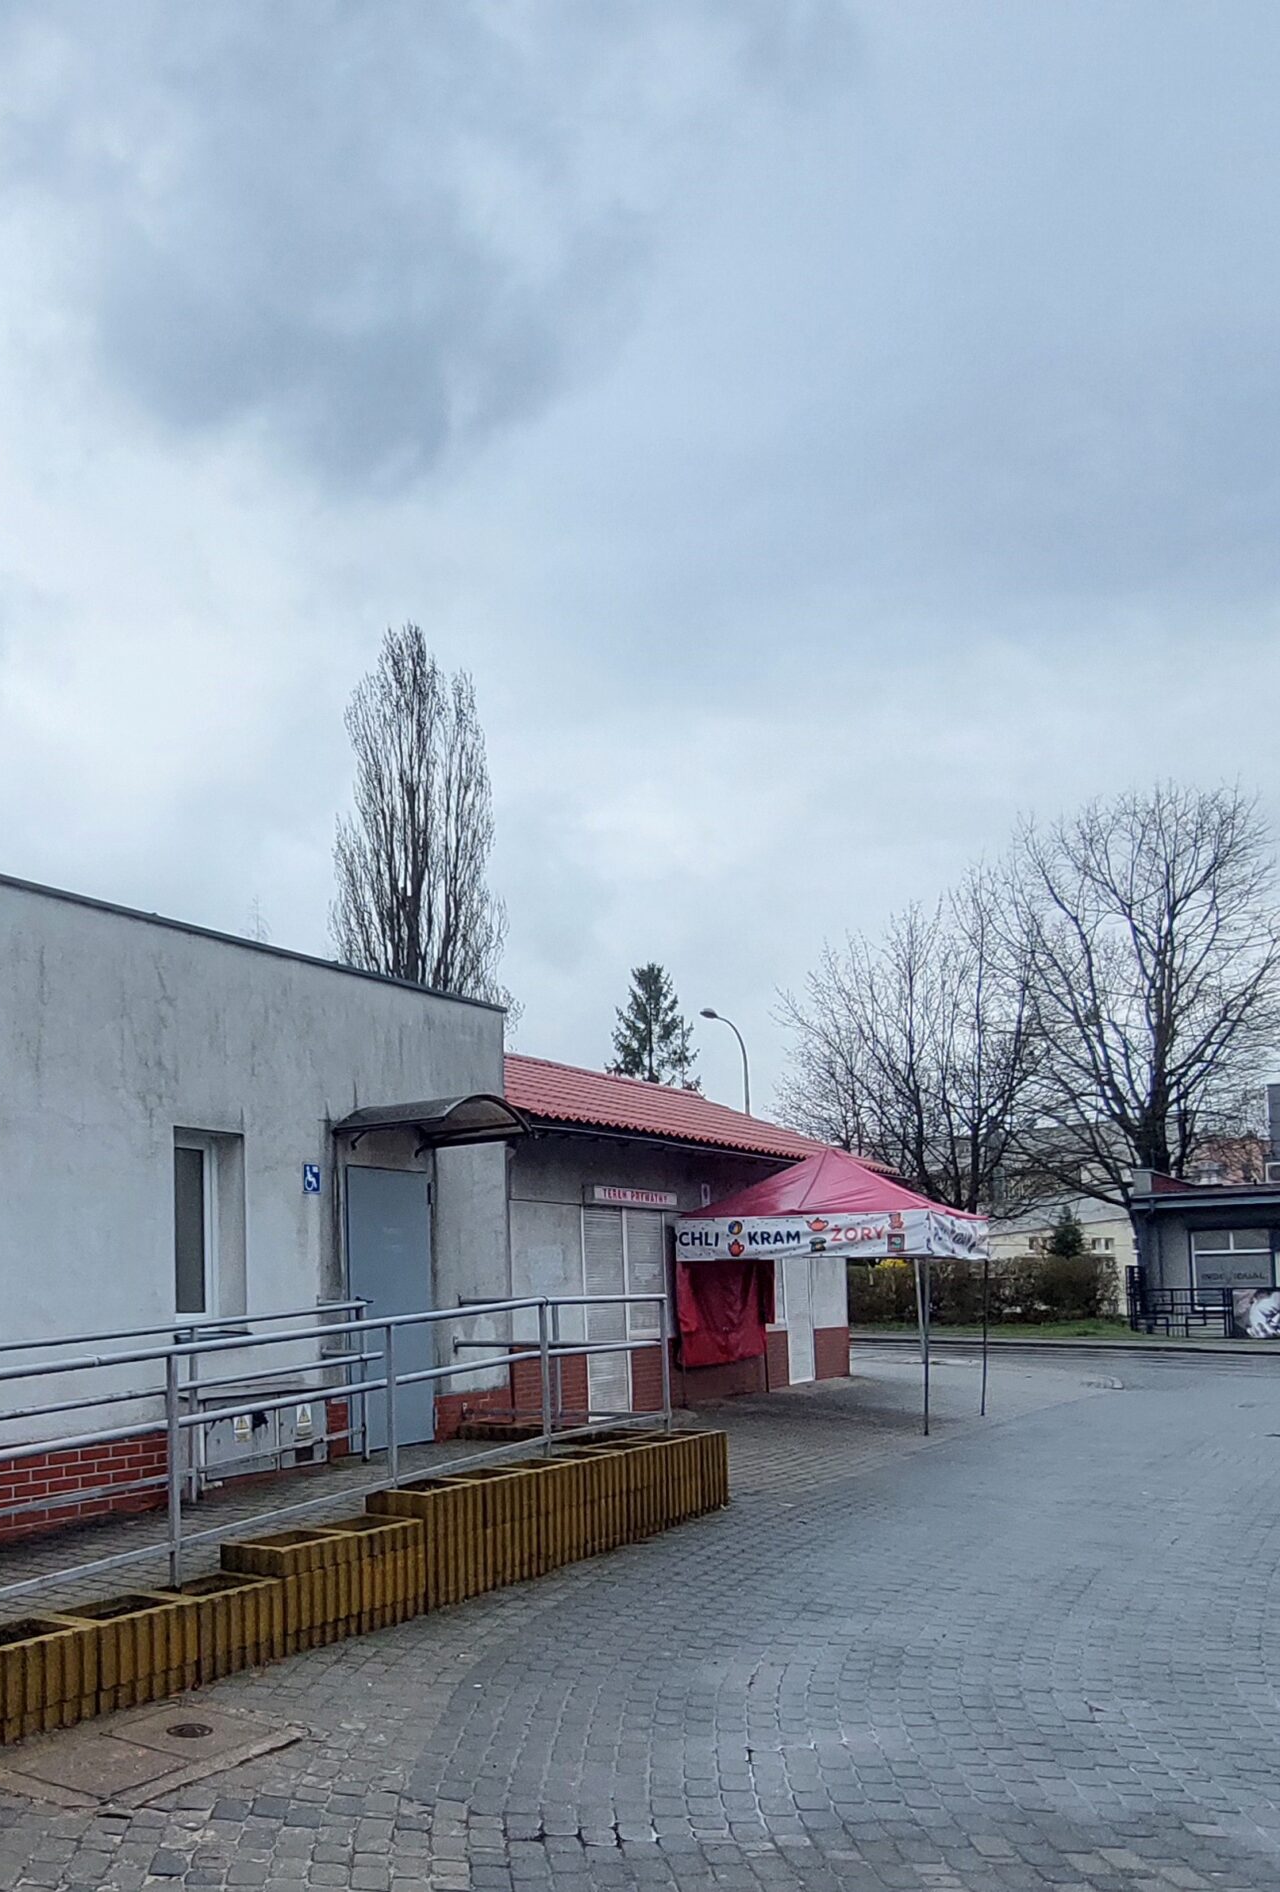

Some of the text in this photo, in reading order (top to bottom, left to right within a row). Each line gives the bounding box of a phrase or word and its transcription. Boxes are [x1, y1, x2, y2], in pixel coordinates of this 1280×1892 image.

[674, 1224, 885, 1247] CHLI KRAM ŻORY
